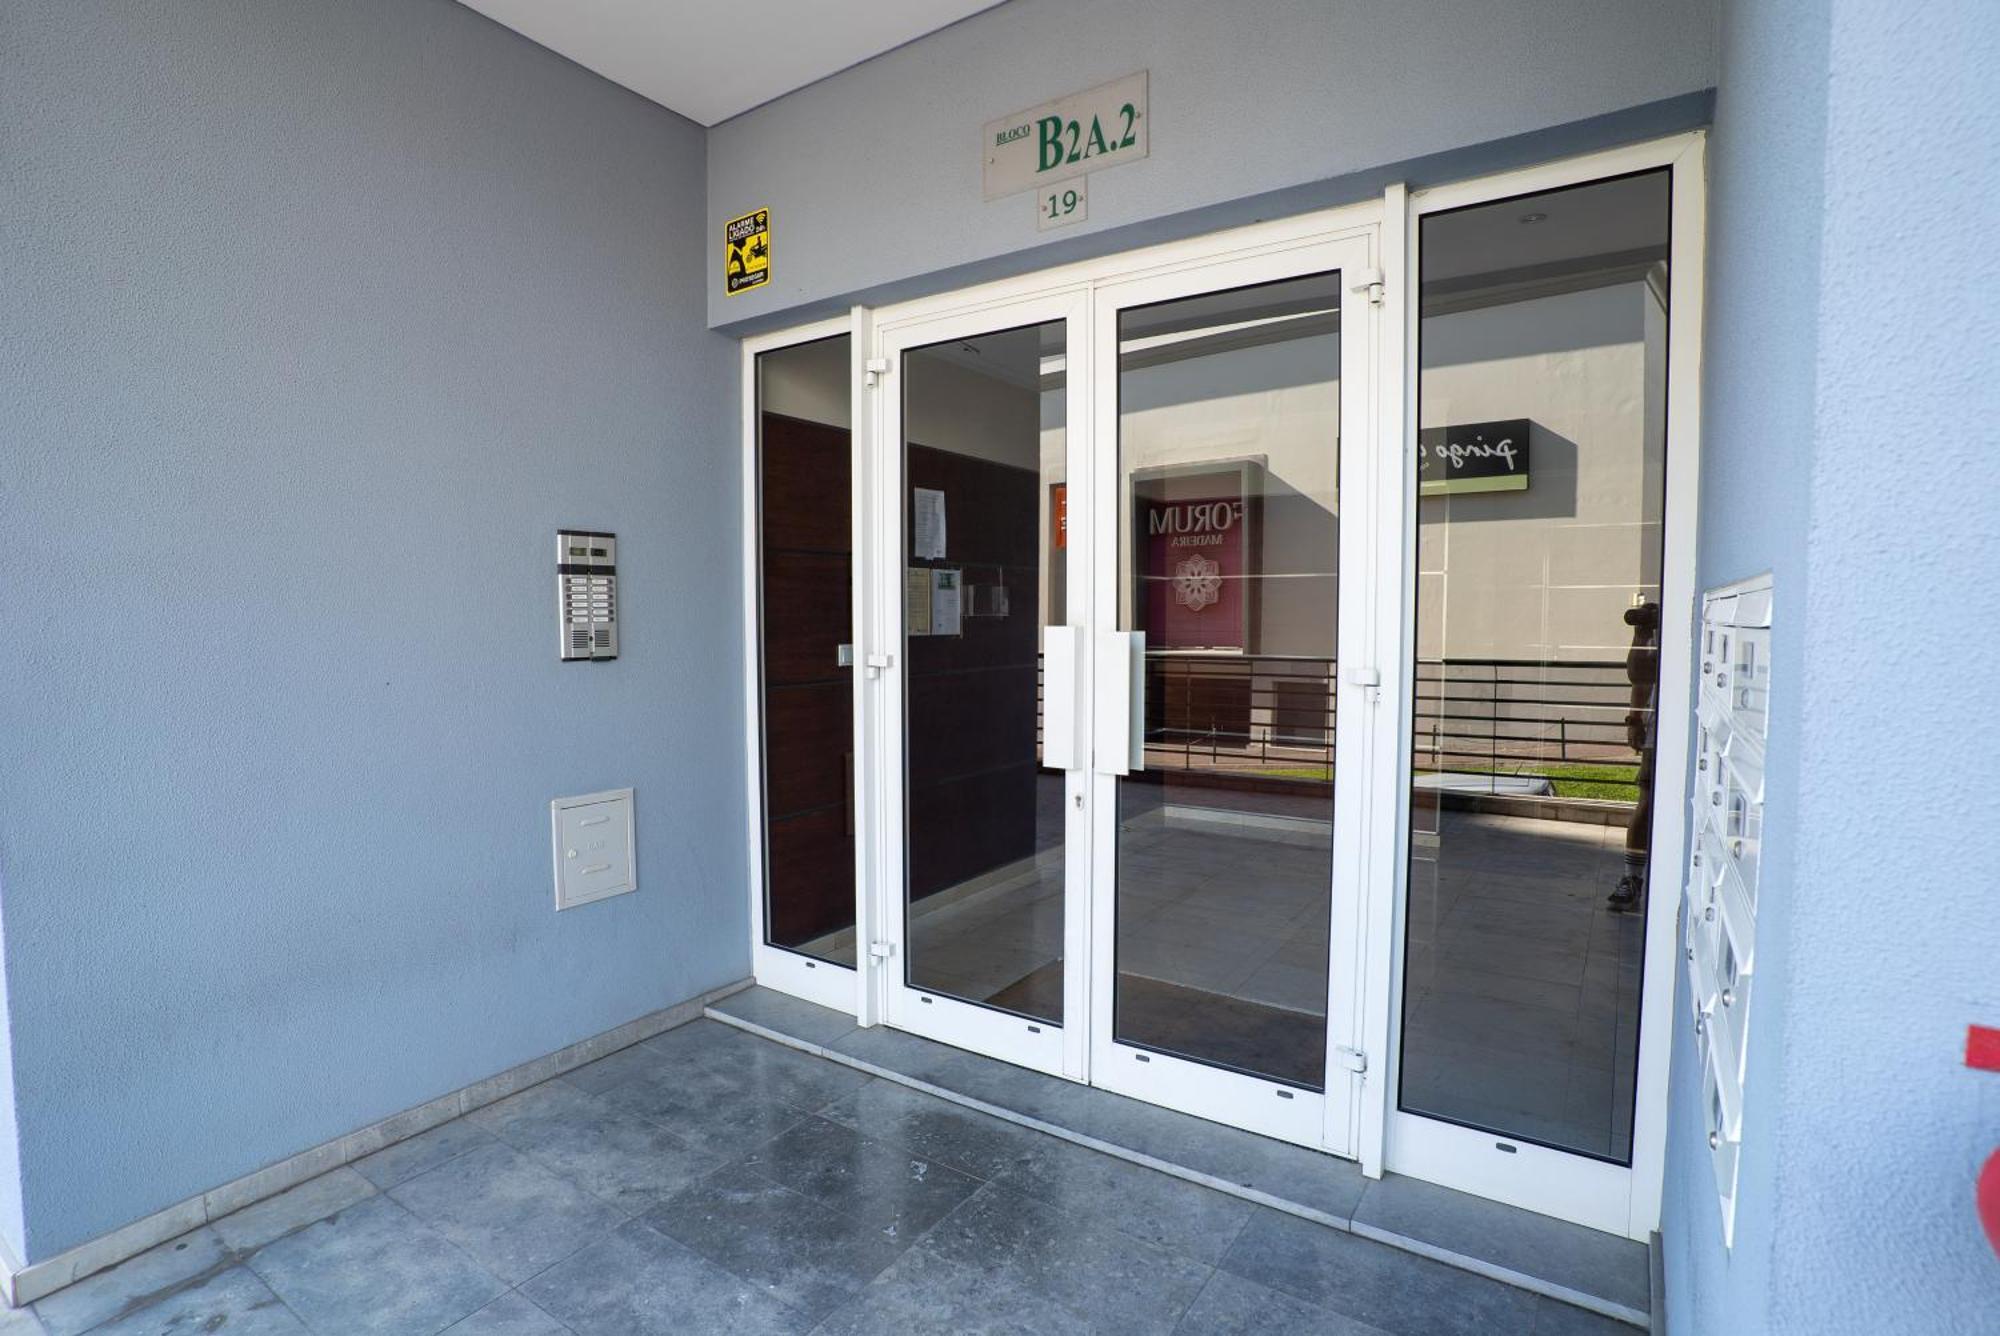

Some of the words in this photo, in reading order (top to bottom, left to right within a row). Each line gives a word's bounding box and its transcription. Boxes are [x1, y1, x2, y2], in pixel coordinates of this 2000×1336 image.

[996, 124, 1031, 146] BLOCO
[1035, 102, 1136, 173] B2A.2
[1048, 190, 1077, 219] 19
